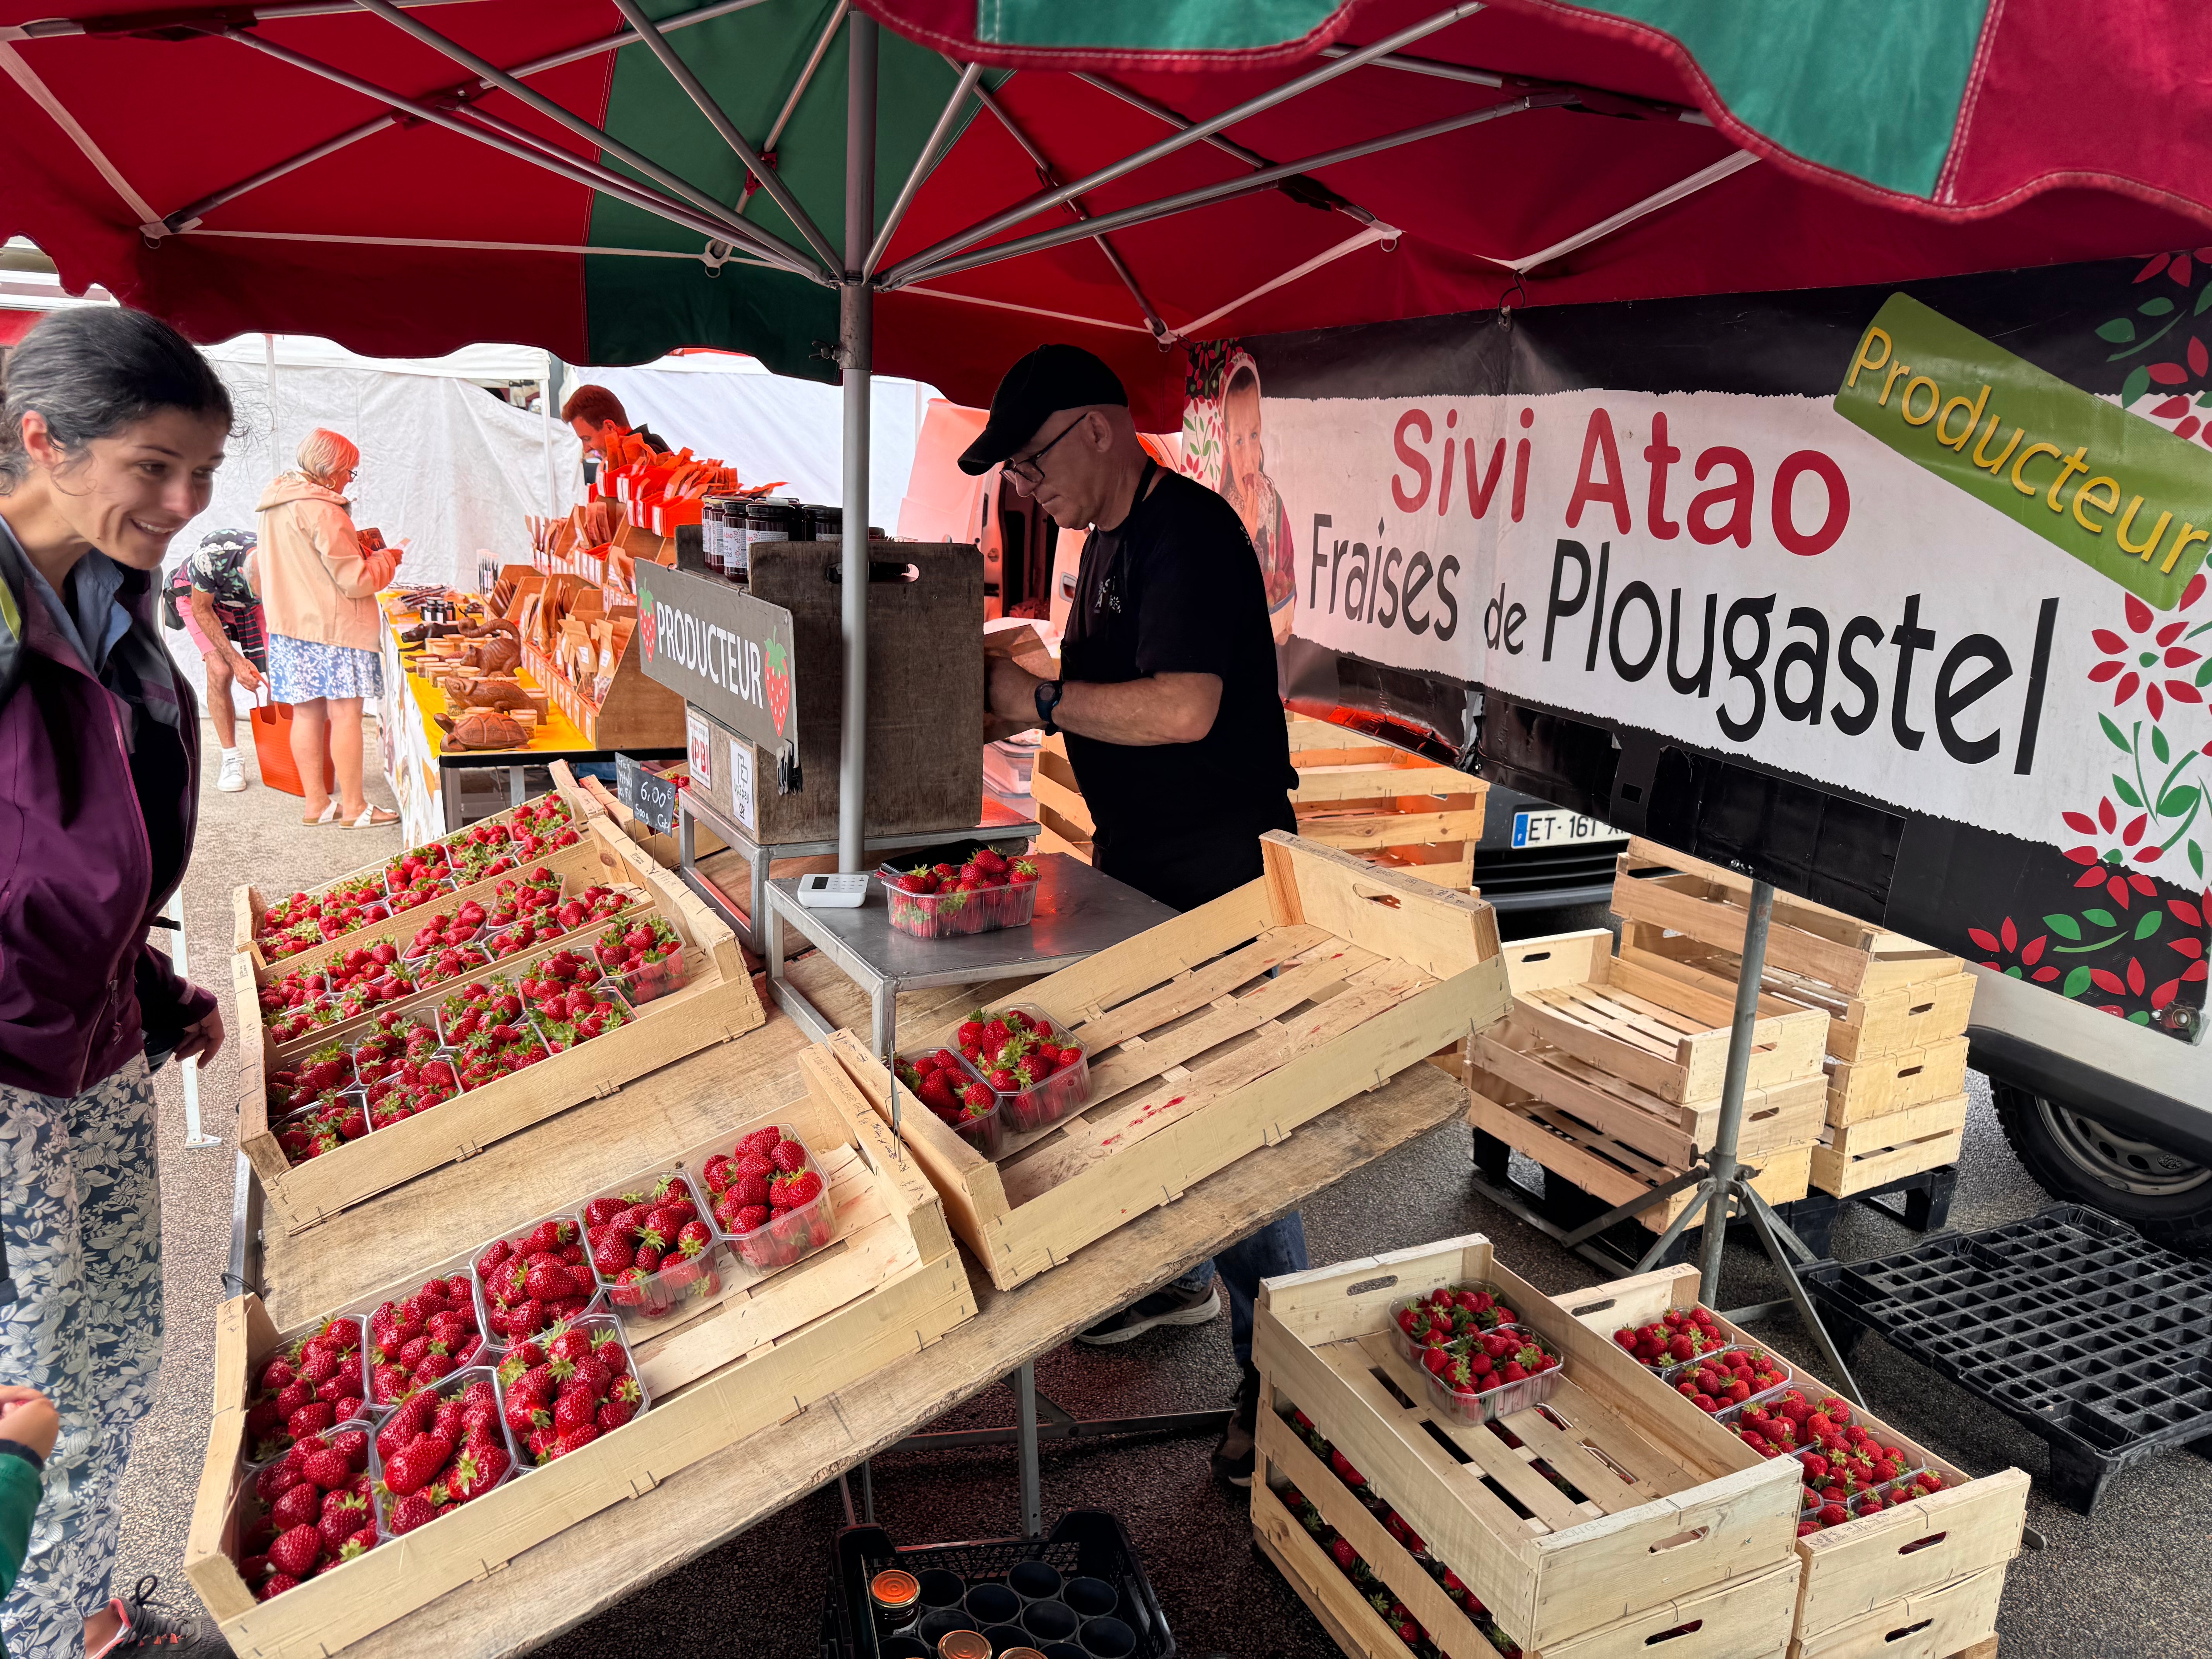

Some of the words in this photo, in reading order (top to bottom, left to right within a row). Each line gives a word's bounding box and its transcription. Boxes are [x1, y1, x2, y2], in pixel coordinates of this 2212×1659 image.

[1391, 407, 1534, 523] Sivi
[1565, 407, 1851, 556] Atao
[1847, 326, 2210, 574] Producteur
[657, 601, 763, 709] PRODUCTEUR
[1309, 513, 1460, 642] Fraises
[1485, 583, 1526, 656] de
[1542, 538, 2060, 776] Plougastel
[1547, 1528, 1585, 1542] GROW
